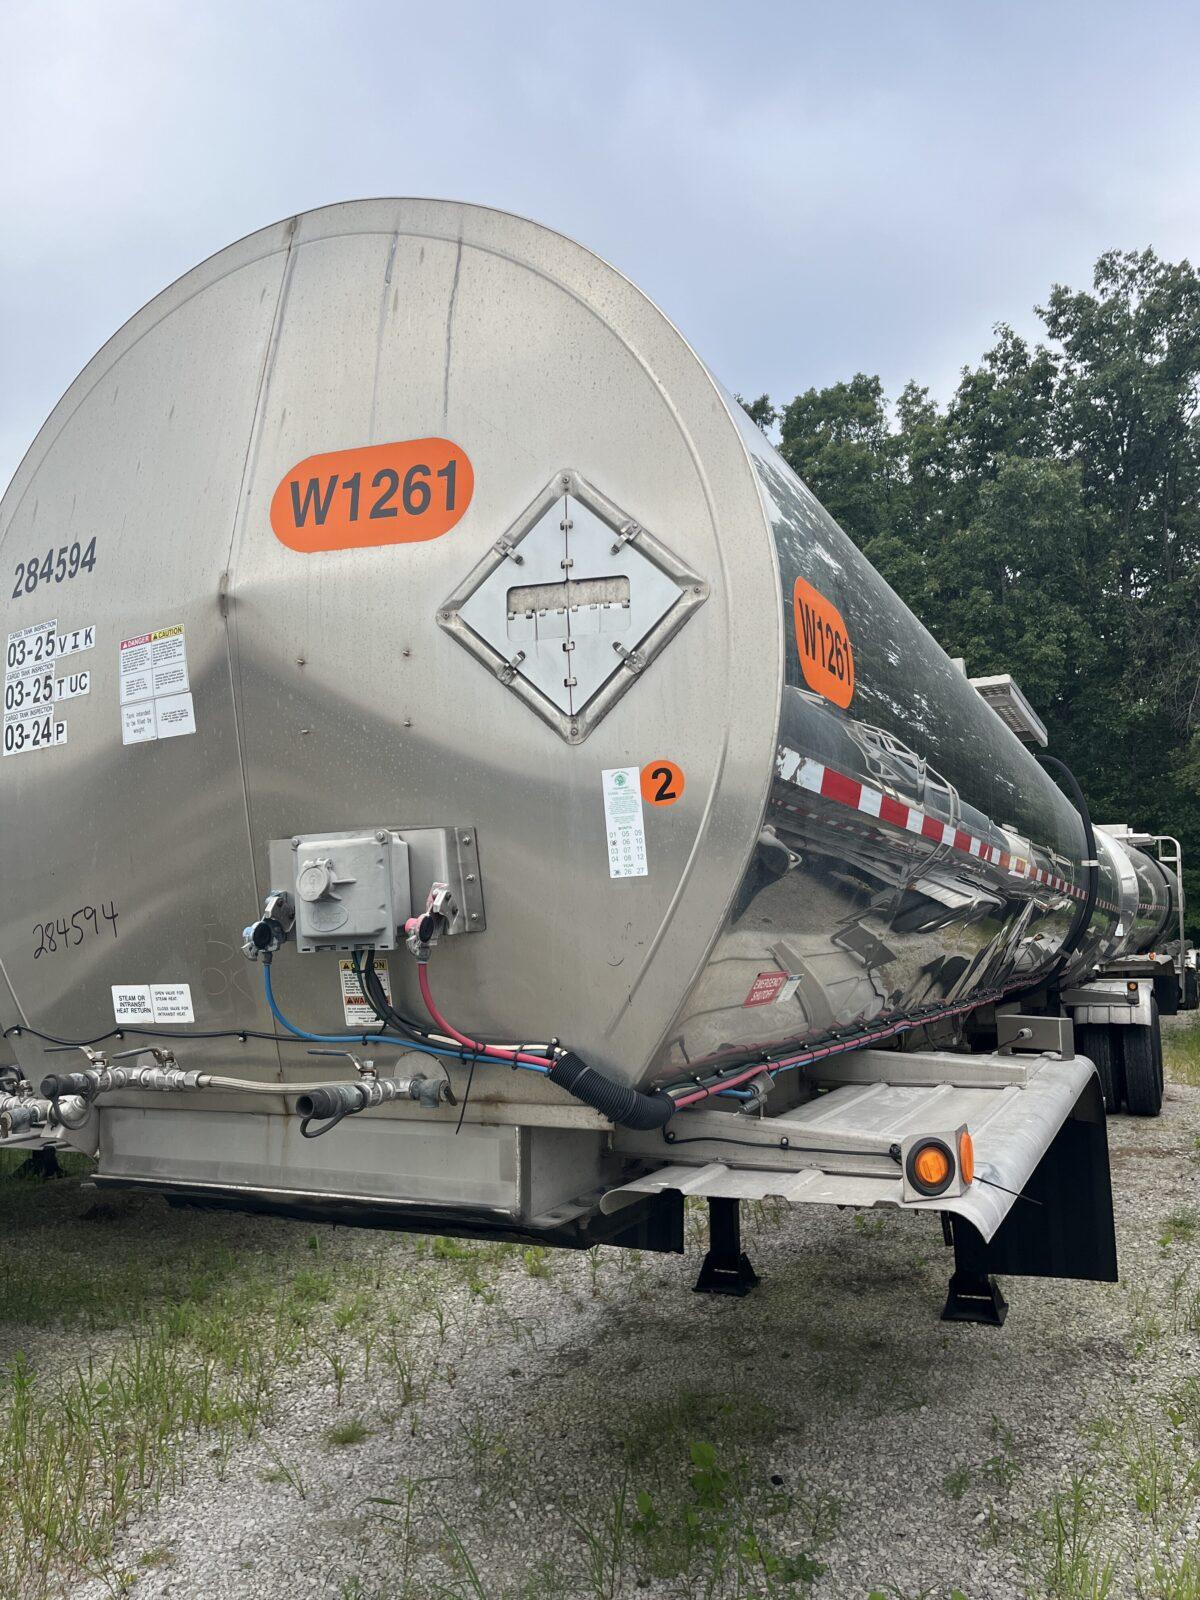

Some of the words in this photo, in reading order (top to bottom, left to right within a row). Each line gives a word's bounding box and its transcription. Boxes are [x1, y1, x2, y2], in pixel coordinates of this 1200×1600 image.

[290, 459, 457, 528] W1261
[12, 536, 97, 599] 284594
[9, 631, 23, 641] CARGO
[34, 621, 56, 632] INSPECTION
[128, 635, 150, 648] DANGER
[158, 626, 182, 638] CAUTION
[798, 598, 850, 686] W1261
[8, 630, 55, 668] 03-25
[7, 672, 21, 680] CARGO
[31, 663, 54, 674] INSPECTION
[5, 675, 53, 710] 03-25
[5, 714, 19, 722] CARGO
[30, 705, 53, 716] INSPECTION
[5, 716, 52, 751] 03-24
[56, 723, 65, 741] P
[651, 767, 677, 802] 2
[33, 901, 118, 959] 284594
[753, 977, 783, 990] EMERGENCY
